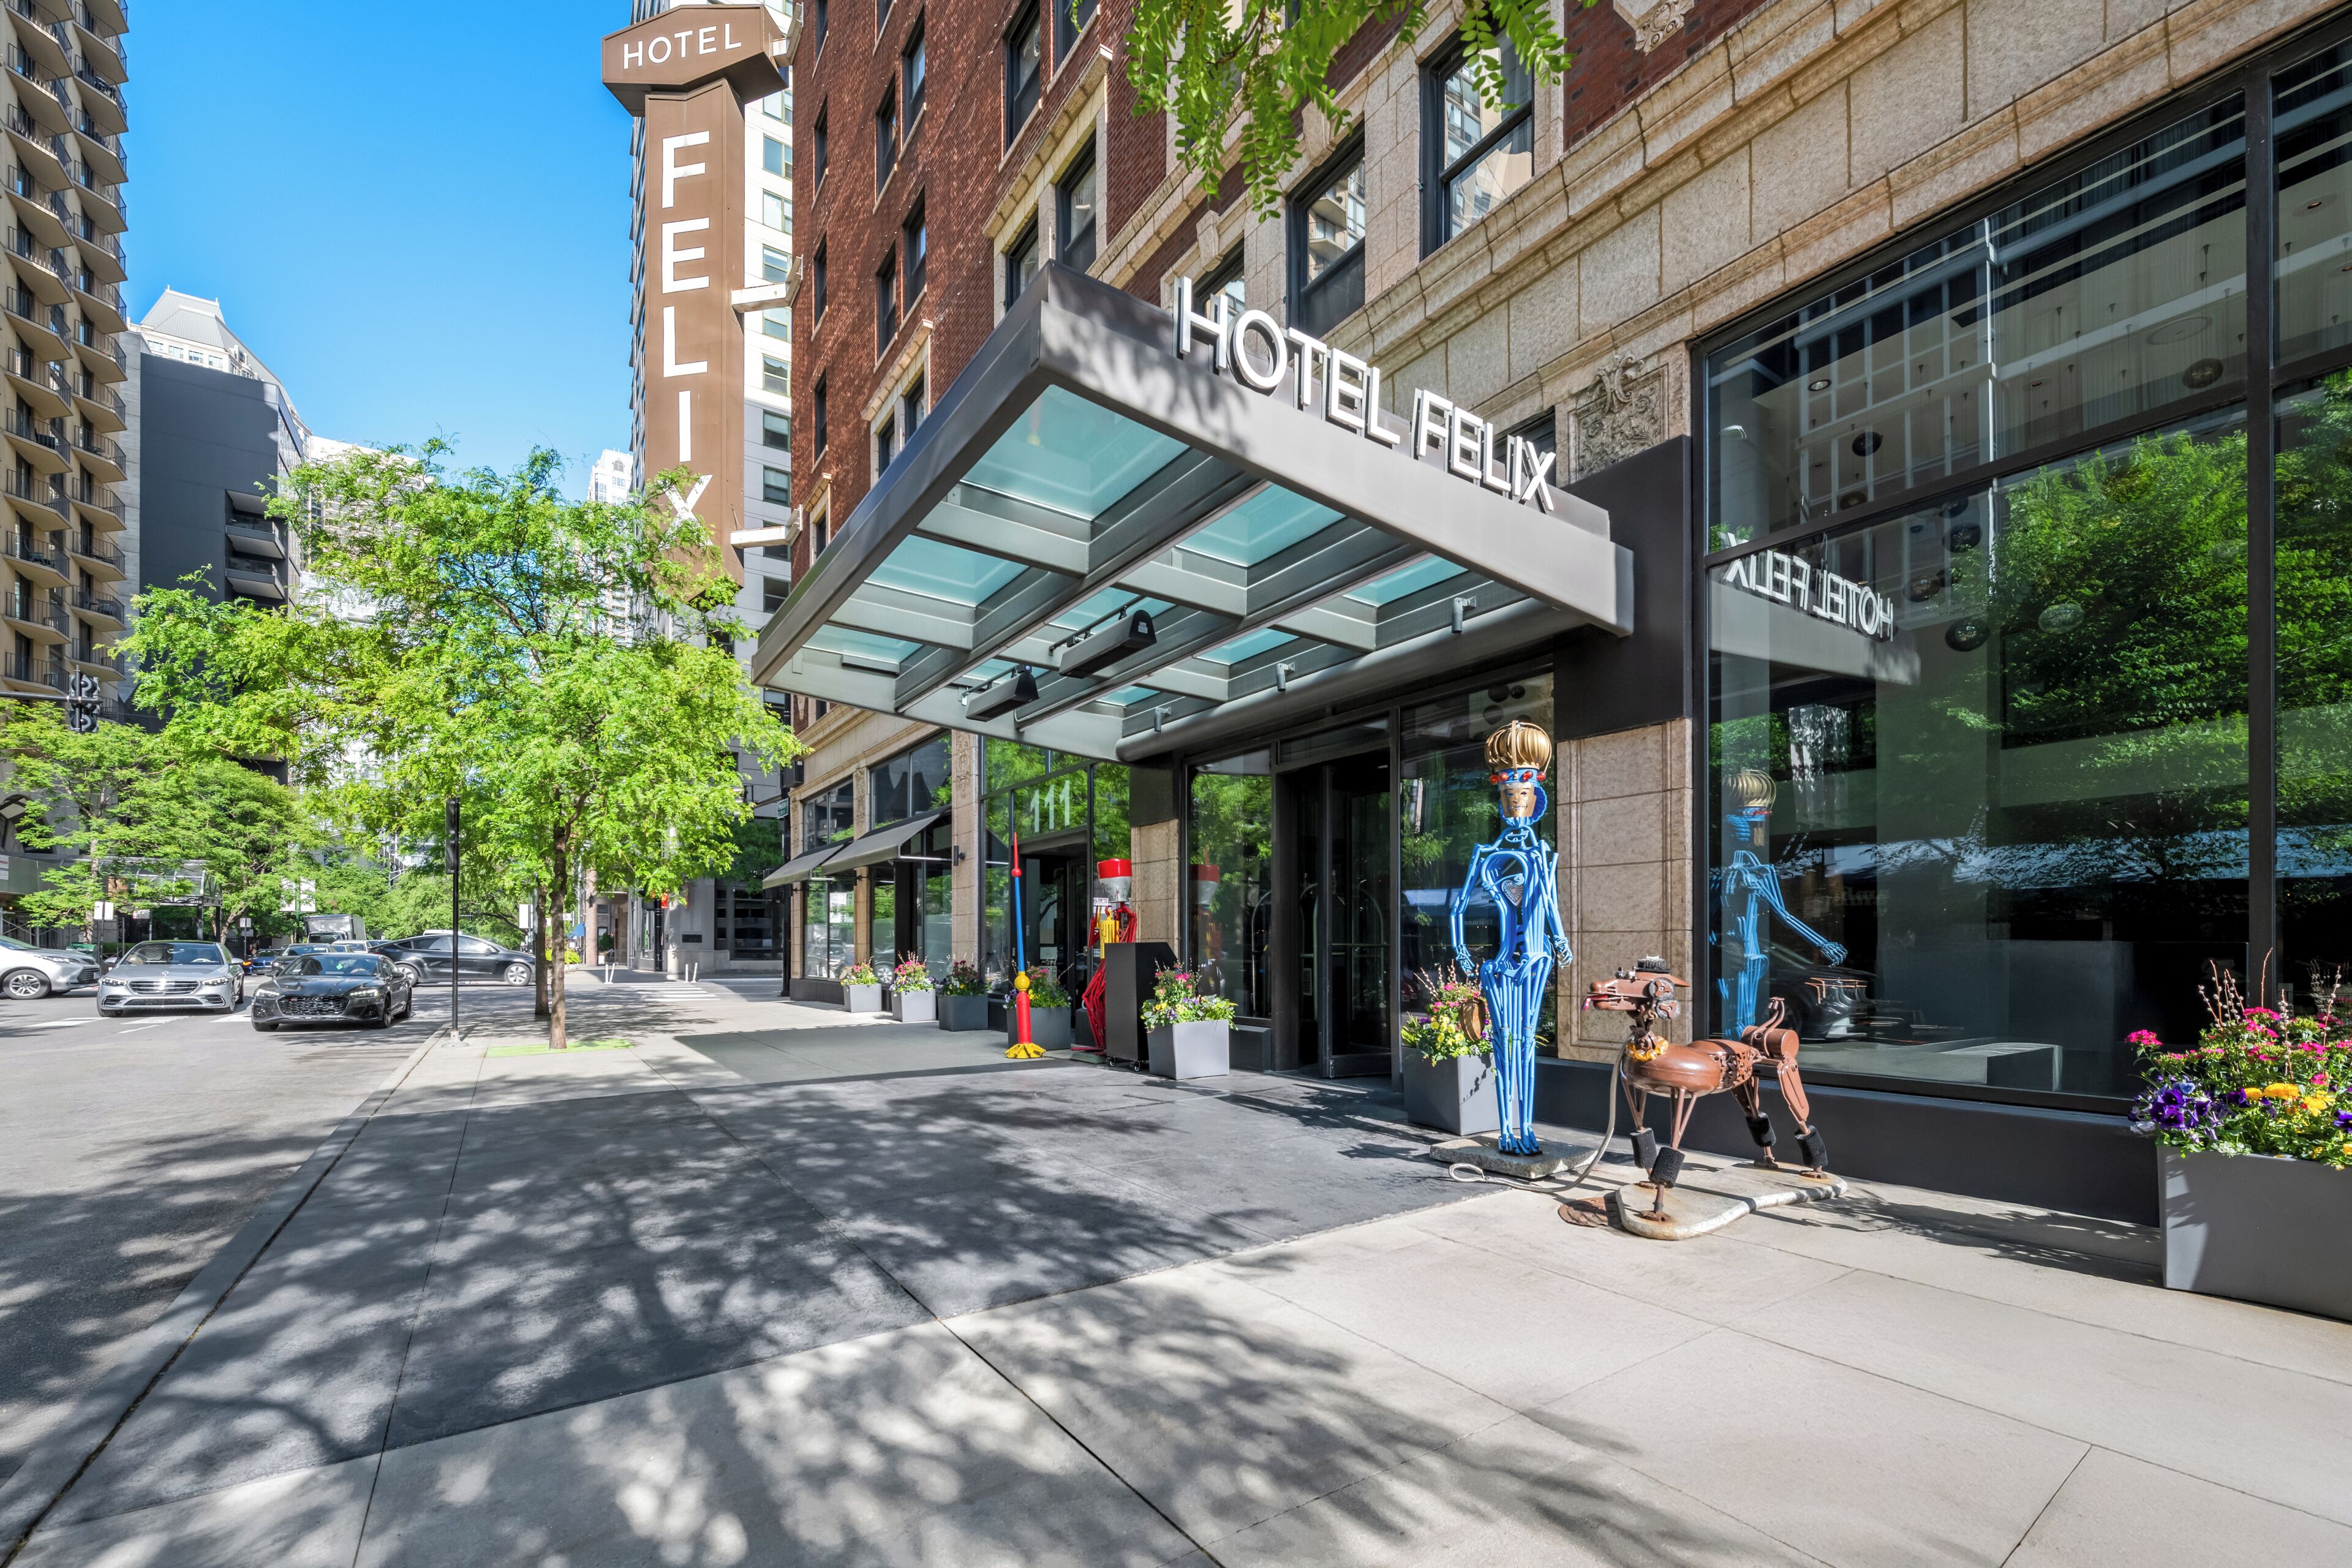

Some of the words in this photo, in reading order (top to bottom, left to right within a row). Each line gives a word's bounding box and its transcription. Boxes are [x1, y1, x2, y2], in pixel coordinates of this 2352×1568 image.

[624, 23, 742, 69] HOTEL
[660, 130, 714, 546] FELIX
[1174, 276, 1400, 445] HOTEL
[1411, 388, 1556, 511] FELIX
[1030, 779, 1071, 832] 111
